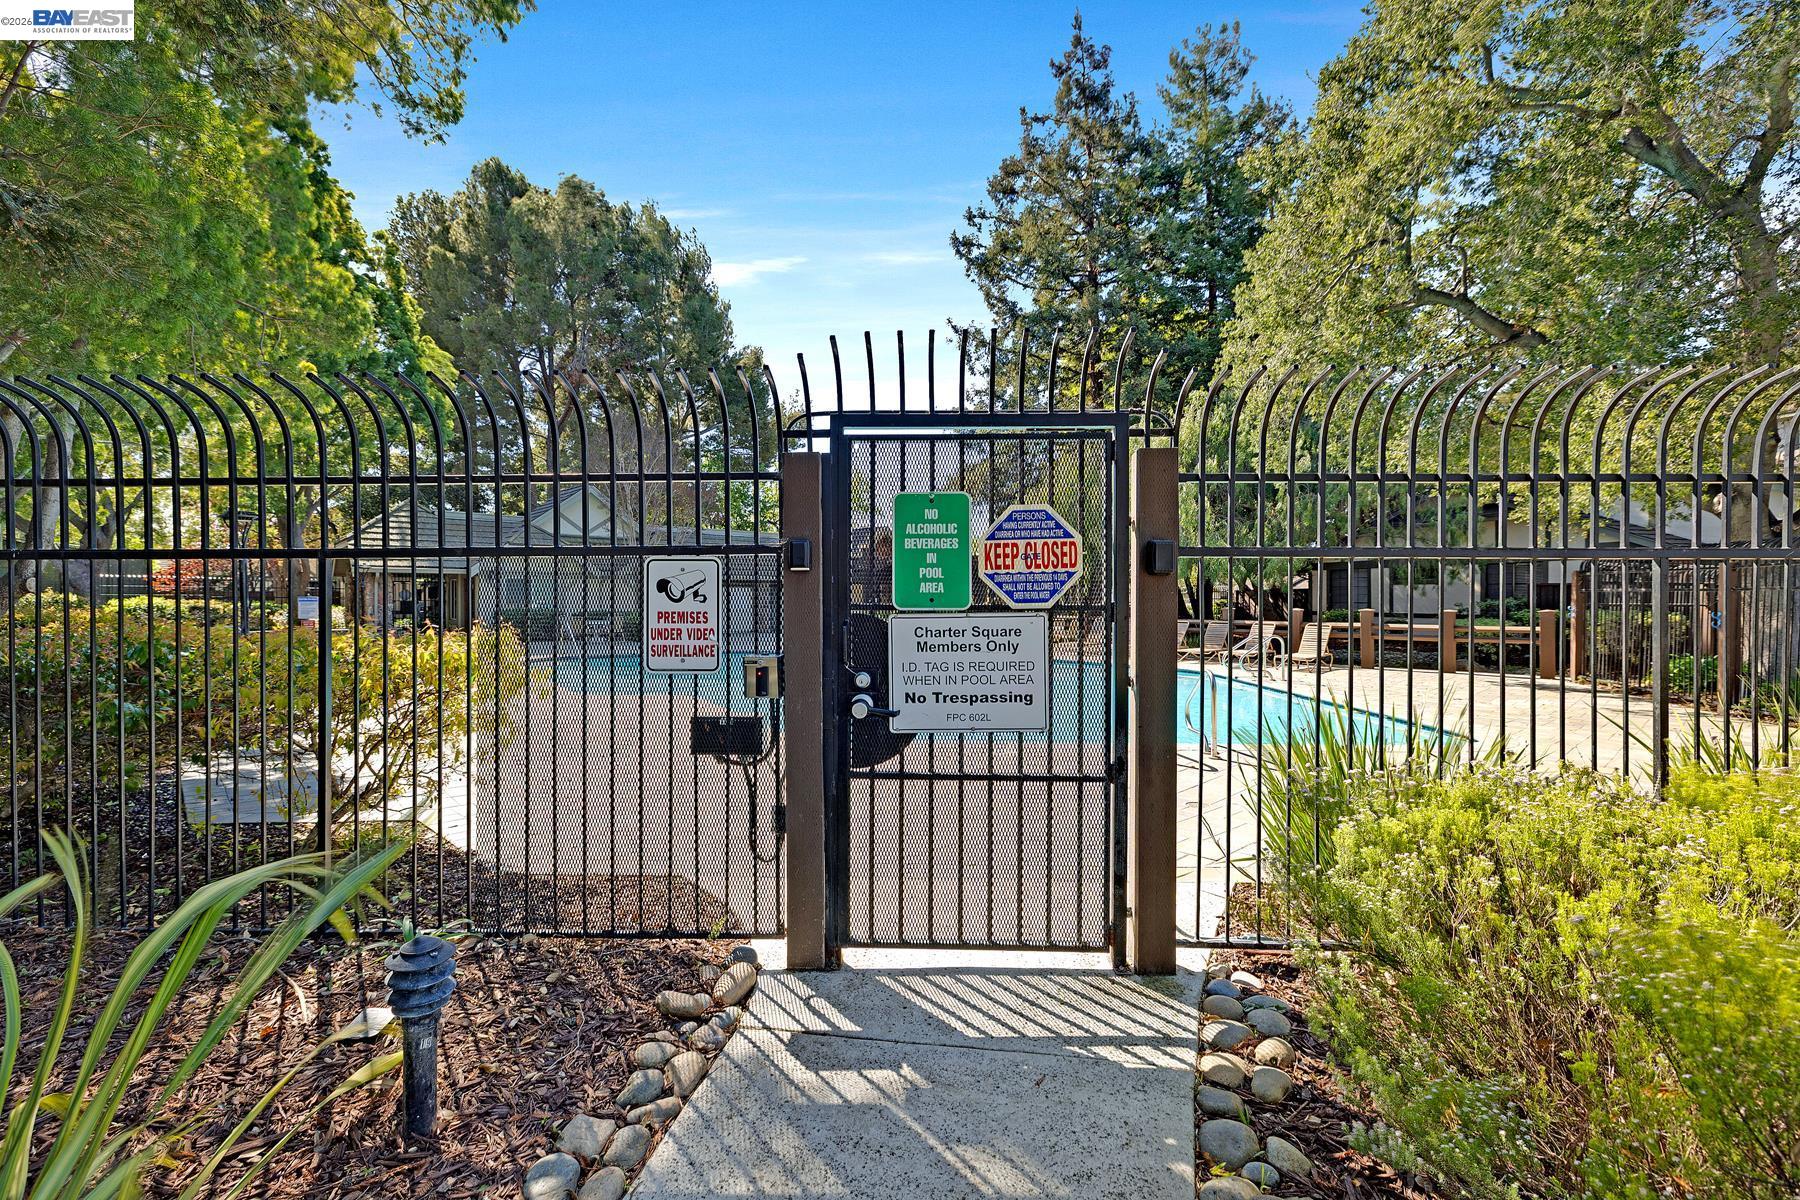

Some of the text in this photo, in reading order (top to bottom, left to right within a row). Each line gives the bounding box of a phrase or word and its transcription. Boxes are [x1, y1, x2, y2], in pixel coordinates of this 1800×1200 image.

[924, 508, 938, 520] NO
[1012, 511, 1046, 520] PERSONS
[905, 523, 958, 535] ALCOHOLIC
[1002, 520, 1056, 529] HAVING CURRENTLY ACTIVE
[994, 529, 1064, 539] DIARRHEA OR WHO HAVE HAD ACTIVE
[904, 538, 959, 549] BEVERAGES
[926, 552, 937, 564] IN
[984, 541, 1078, 570] KEEP CLOSED
[1020, 552, 1041, 561] GATE
[919, 567, 944, 579] POOL
[994, 573, 1068, 583] DIARRHEA WITHIN THE PREVIOUS 14 DAYS
[919, 582, 945, 593] AREA
[1002, 582, 1061, 591] SHALL NOT BE ALLOWED TO
[1013, 592, 1024, 600] ENTER
[1030, 591, 1039, 599] POOL
[1039, 591, 1050, 599] WATER
[657, 611, 709, 624] PREMISES
[650, 628, 683, 641] UNDER
[914, 626, 1022, 640] Charter Square
[650, 645, 716, 657] SURVEILLANCE
[916, 640, 1020, 654] Members Only
[902, 661, 1035, 672] I.D. TAG IS REQUIRED
[902, 675, 1035, 686] WHEN IN POOL AREA
[904, 691, 1034, 706] No Trespassing
[946, 713, 991, 722] FPC 602L
